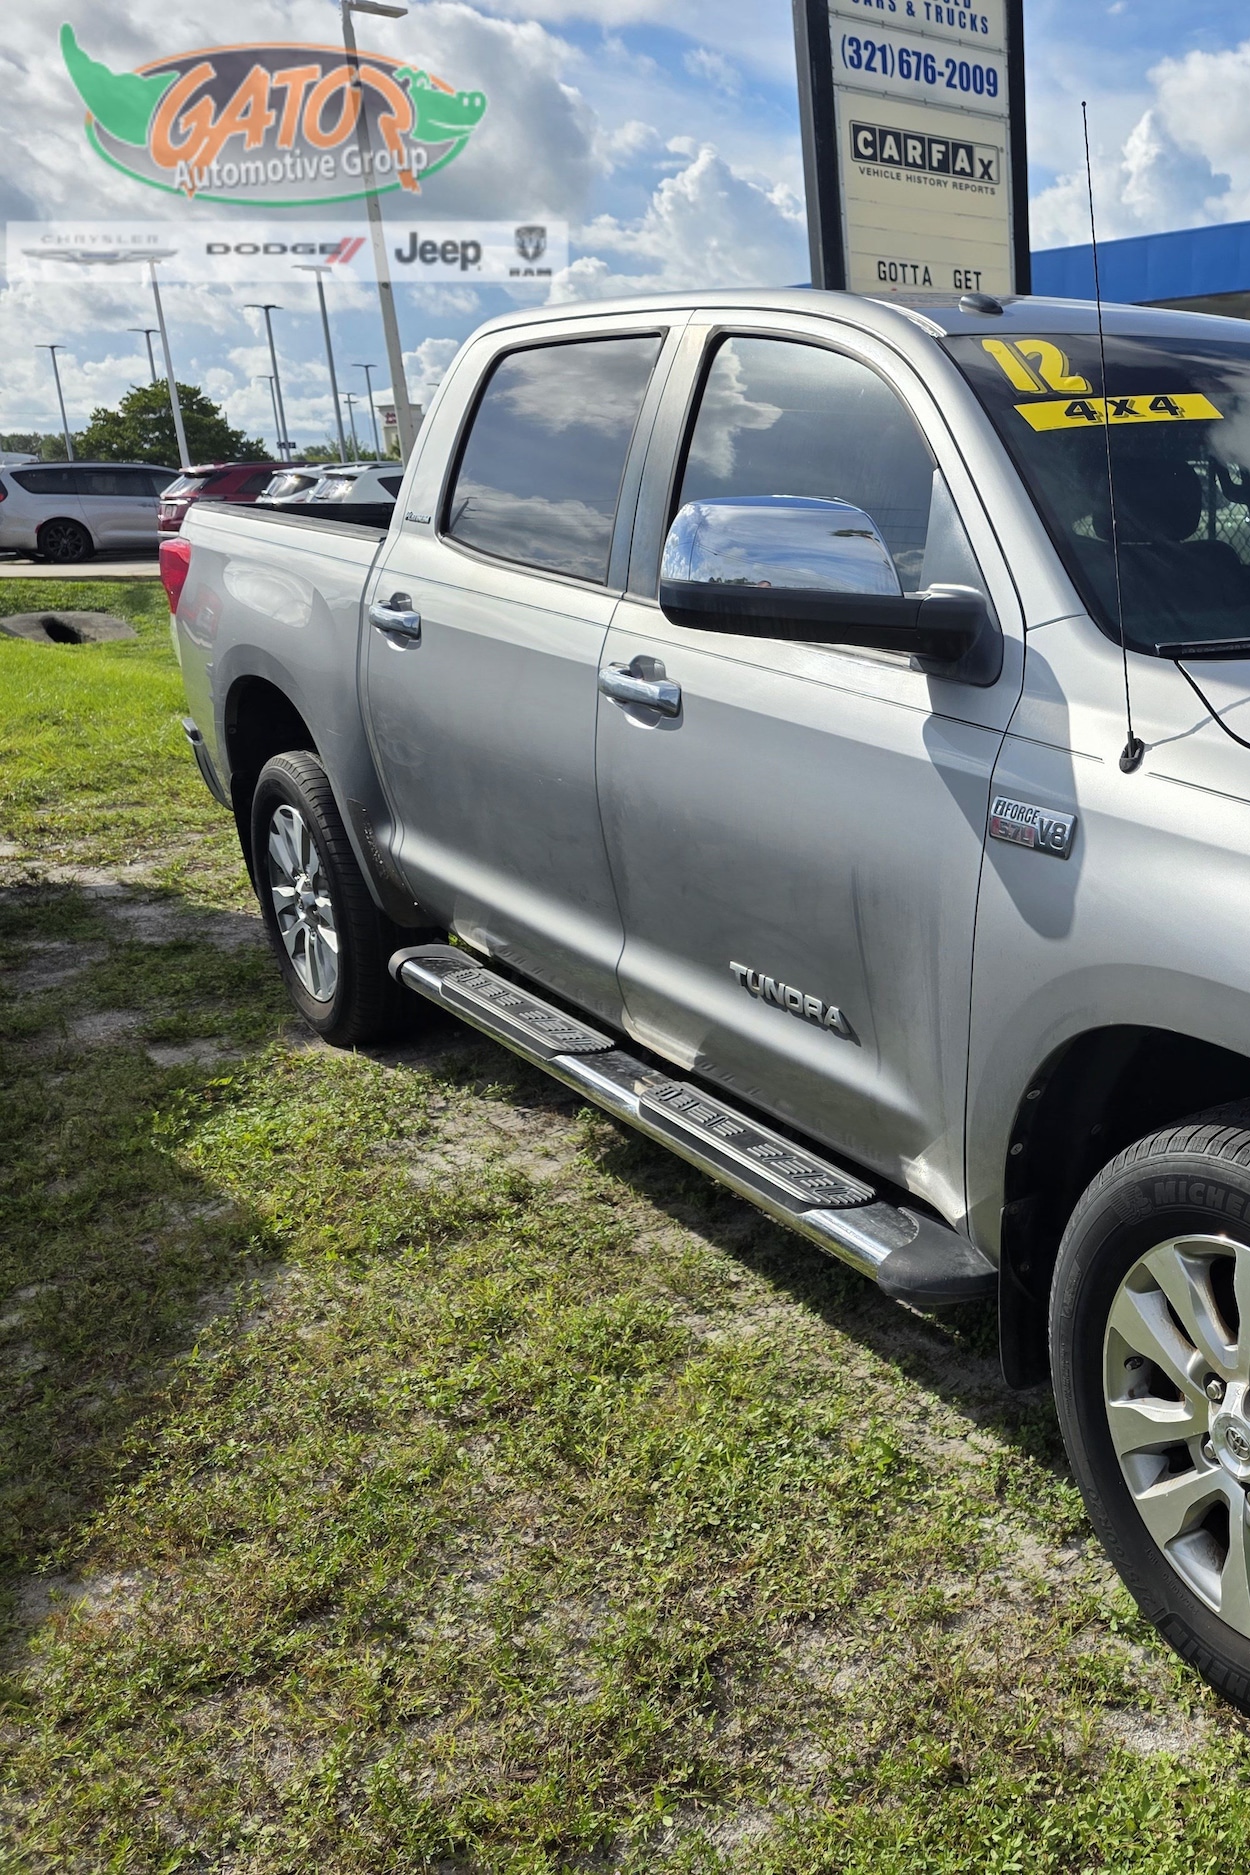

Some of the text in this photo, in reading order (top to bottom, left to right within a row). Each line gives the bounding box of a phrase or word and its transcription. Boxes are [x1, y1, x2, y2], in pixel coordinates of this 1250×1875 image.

[924, 2, 989, 34] TRUCKS
[857, 130, 993, 180] CARFAX
[859, 166, 995, 195] VEHICLE HISTORY REPORTS
[878, 261, 982, 291] GOTTA GET
[981, 338, 1092, 394] 12
[1039, 818, 1068, 850] V8
[729, 961, 852, 1034] TUNDRA
